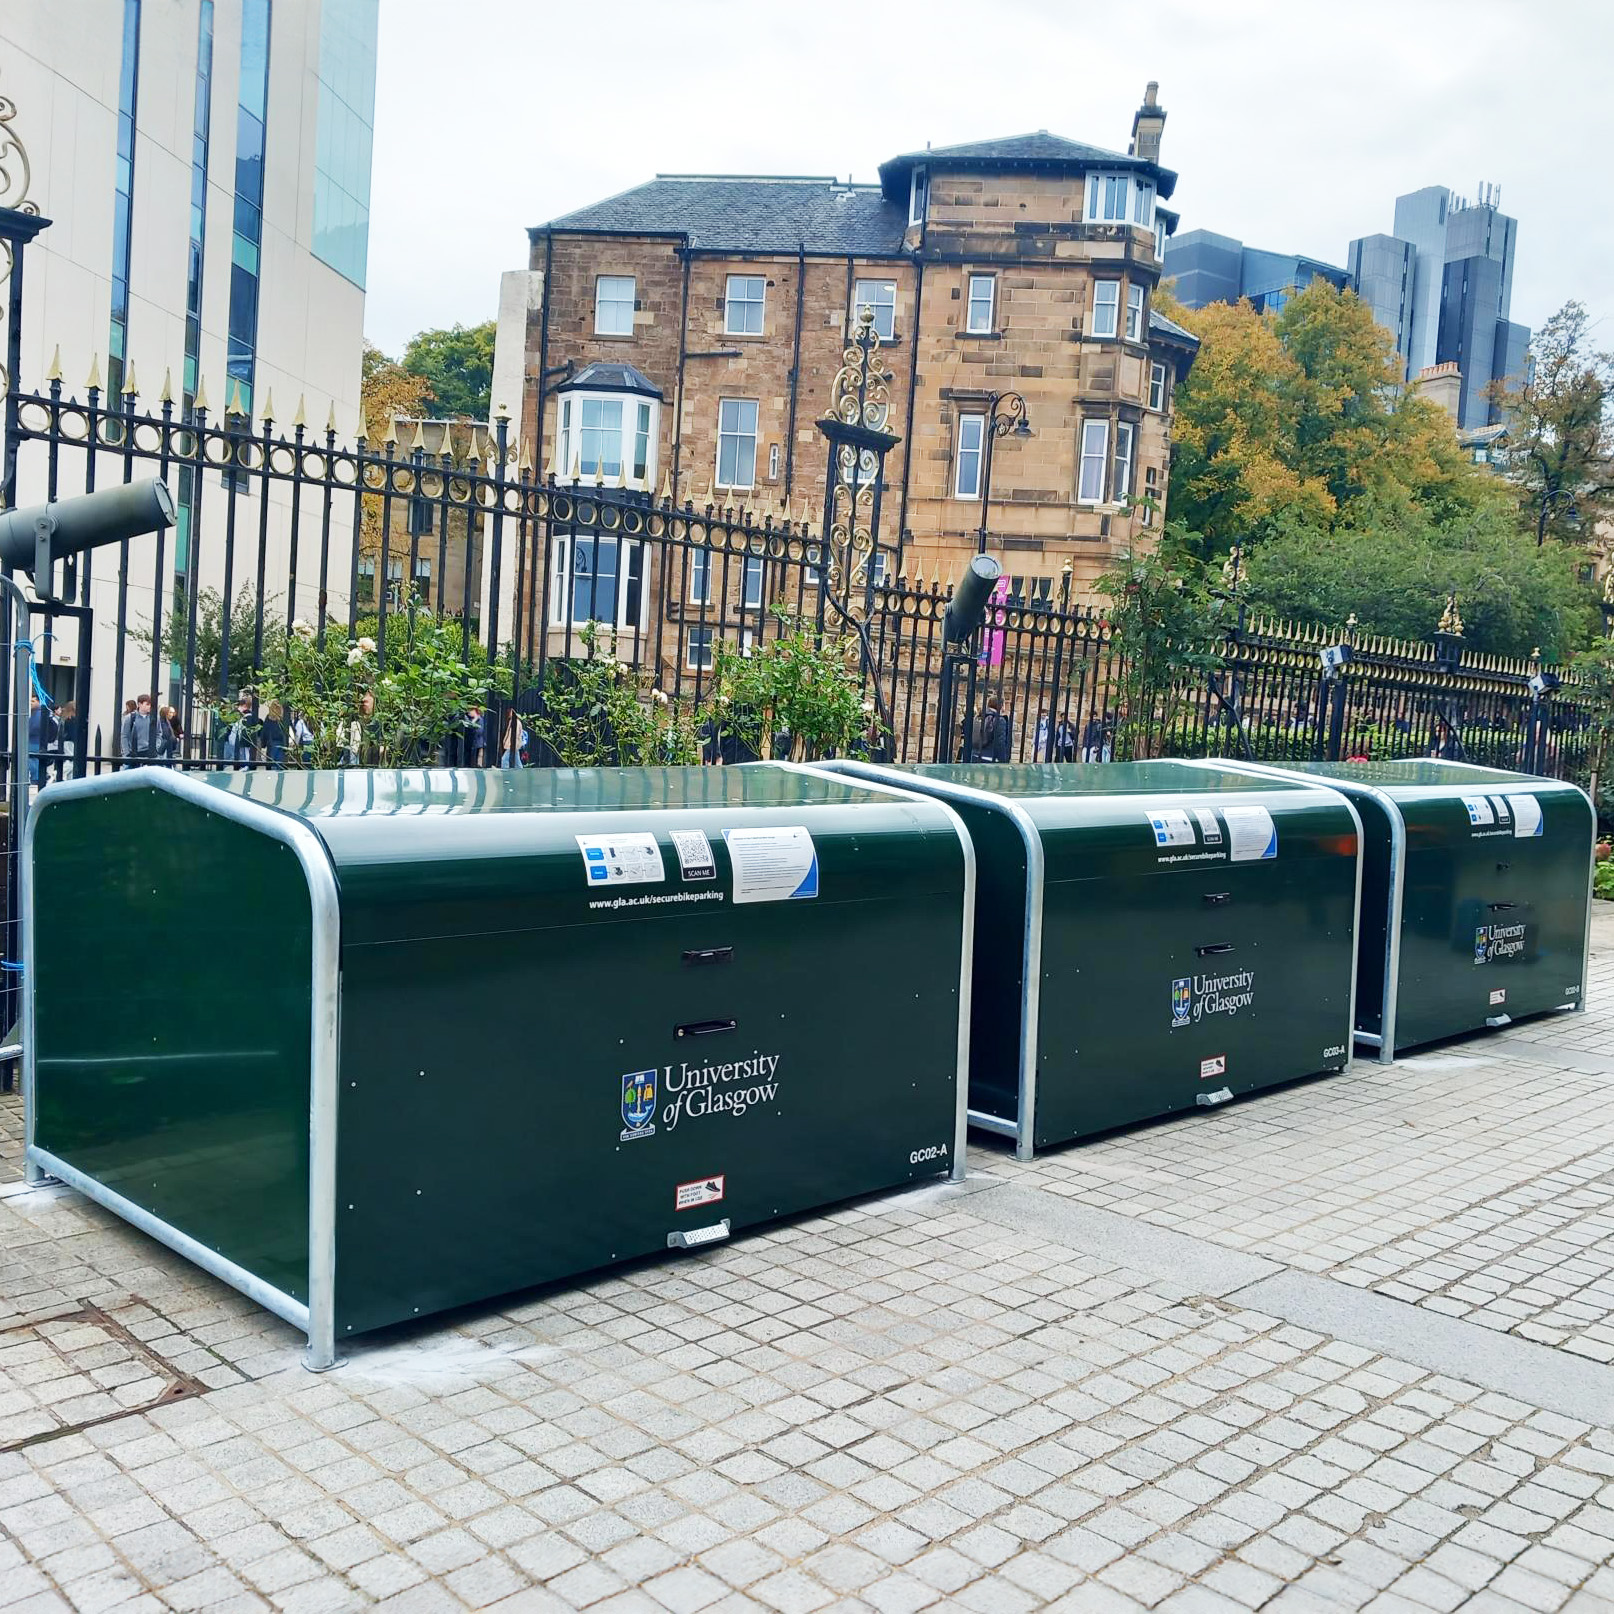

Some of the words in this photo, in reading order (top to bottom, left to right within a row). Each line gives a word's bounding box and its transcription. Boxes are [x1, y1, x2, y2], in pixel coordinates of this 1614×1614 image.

[589, 890, 724, 909] www.gla.ac.uk/securebikeparking
[1488, 921, 1527, 940] University
[1487, 940, 1496, 962] of
[1494, 939, 1525, 958] Glasgow
[1193, 968, 1254, 995] University
[1193, 994, 1206, 1022] of
[1204, 992, 1254, 1015] Glasgow
[663, 1050, 780, 1092] University
[662, 1091, 687, 1131] of
[685, 1083, 779, 1117] Glasgow
[909, 1143, 948, 1164] GC02-A
